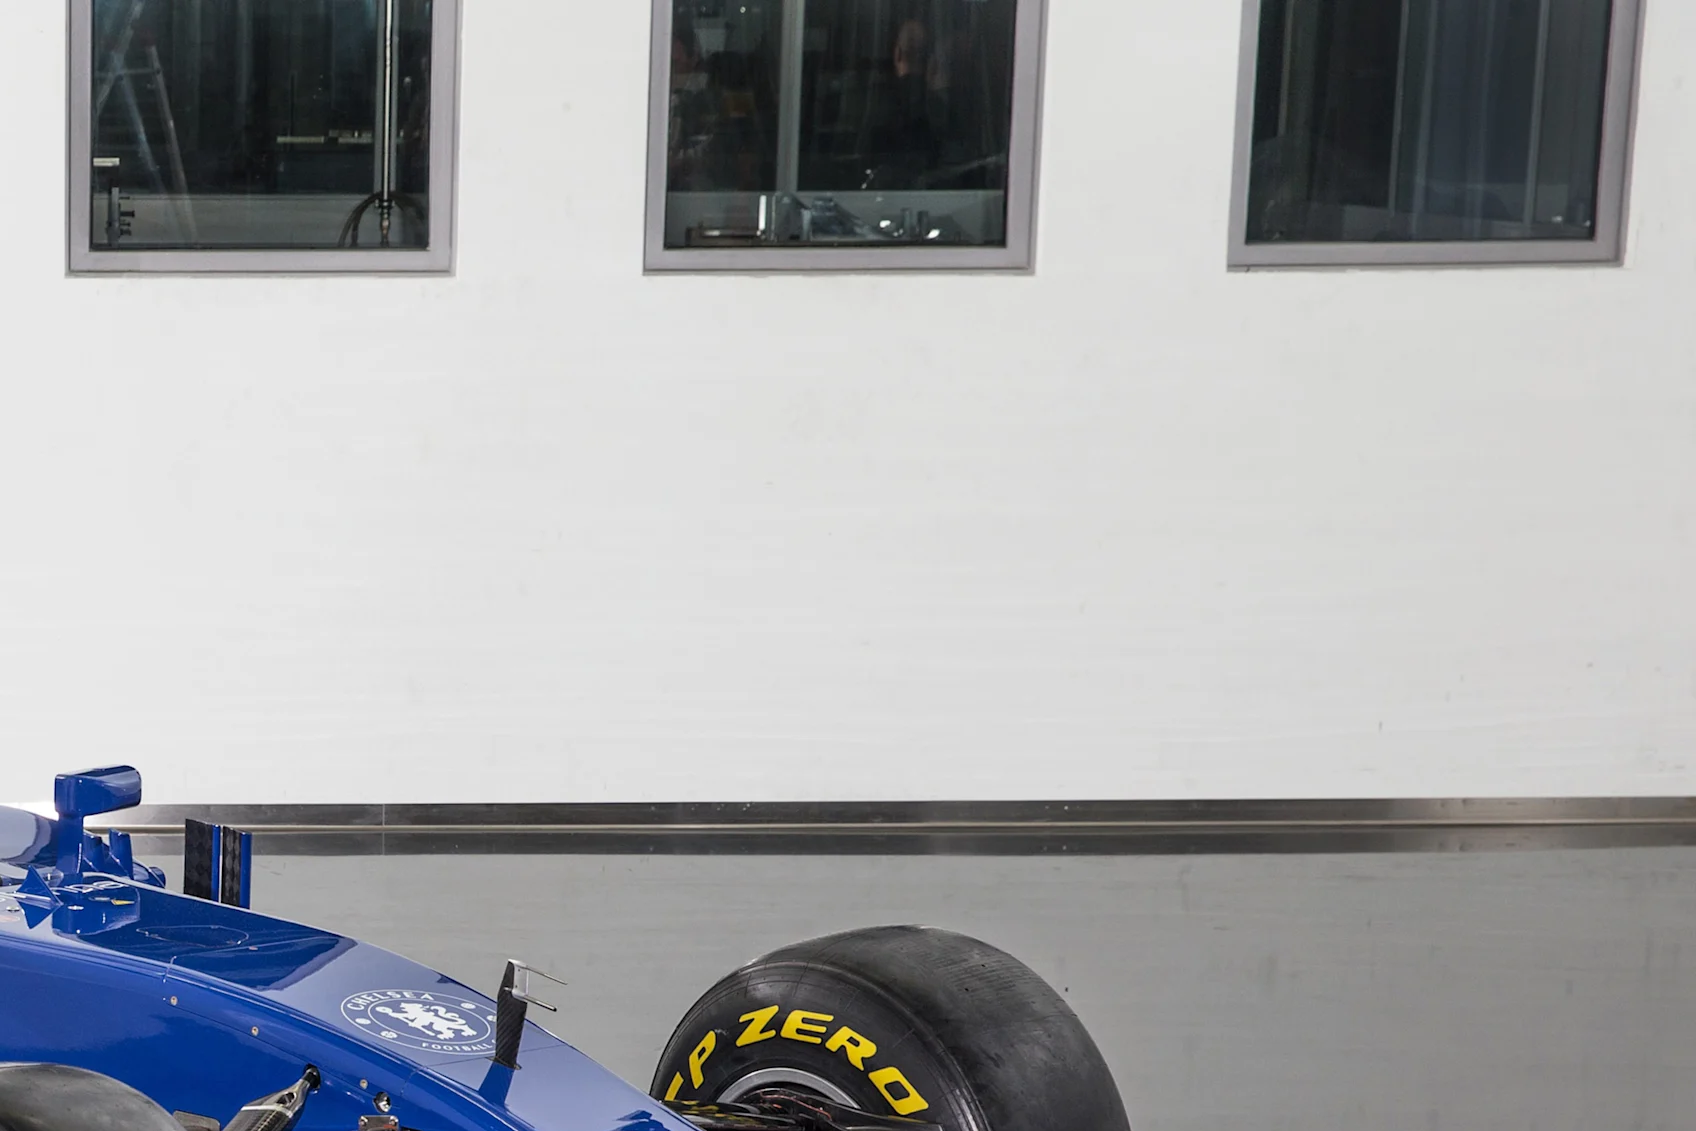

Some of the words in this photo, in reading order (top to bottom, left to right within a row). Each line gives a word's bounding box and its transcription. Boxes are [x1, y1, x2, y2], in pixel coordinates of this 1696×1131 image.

[346, 991, 434, 1011] CHELSEA
[421, 1042, 493, 1052] FOOTBALL
[688, 1030, 716, 1089] P
[735, 1005, 929, 1115] ZERO
